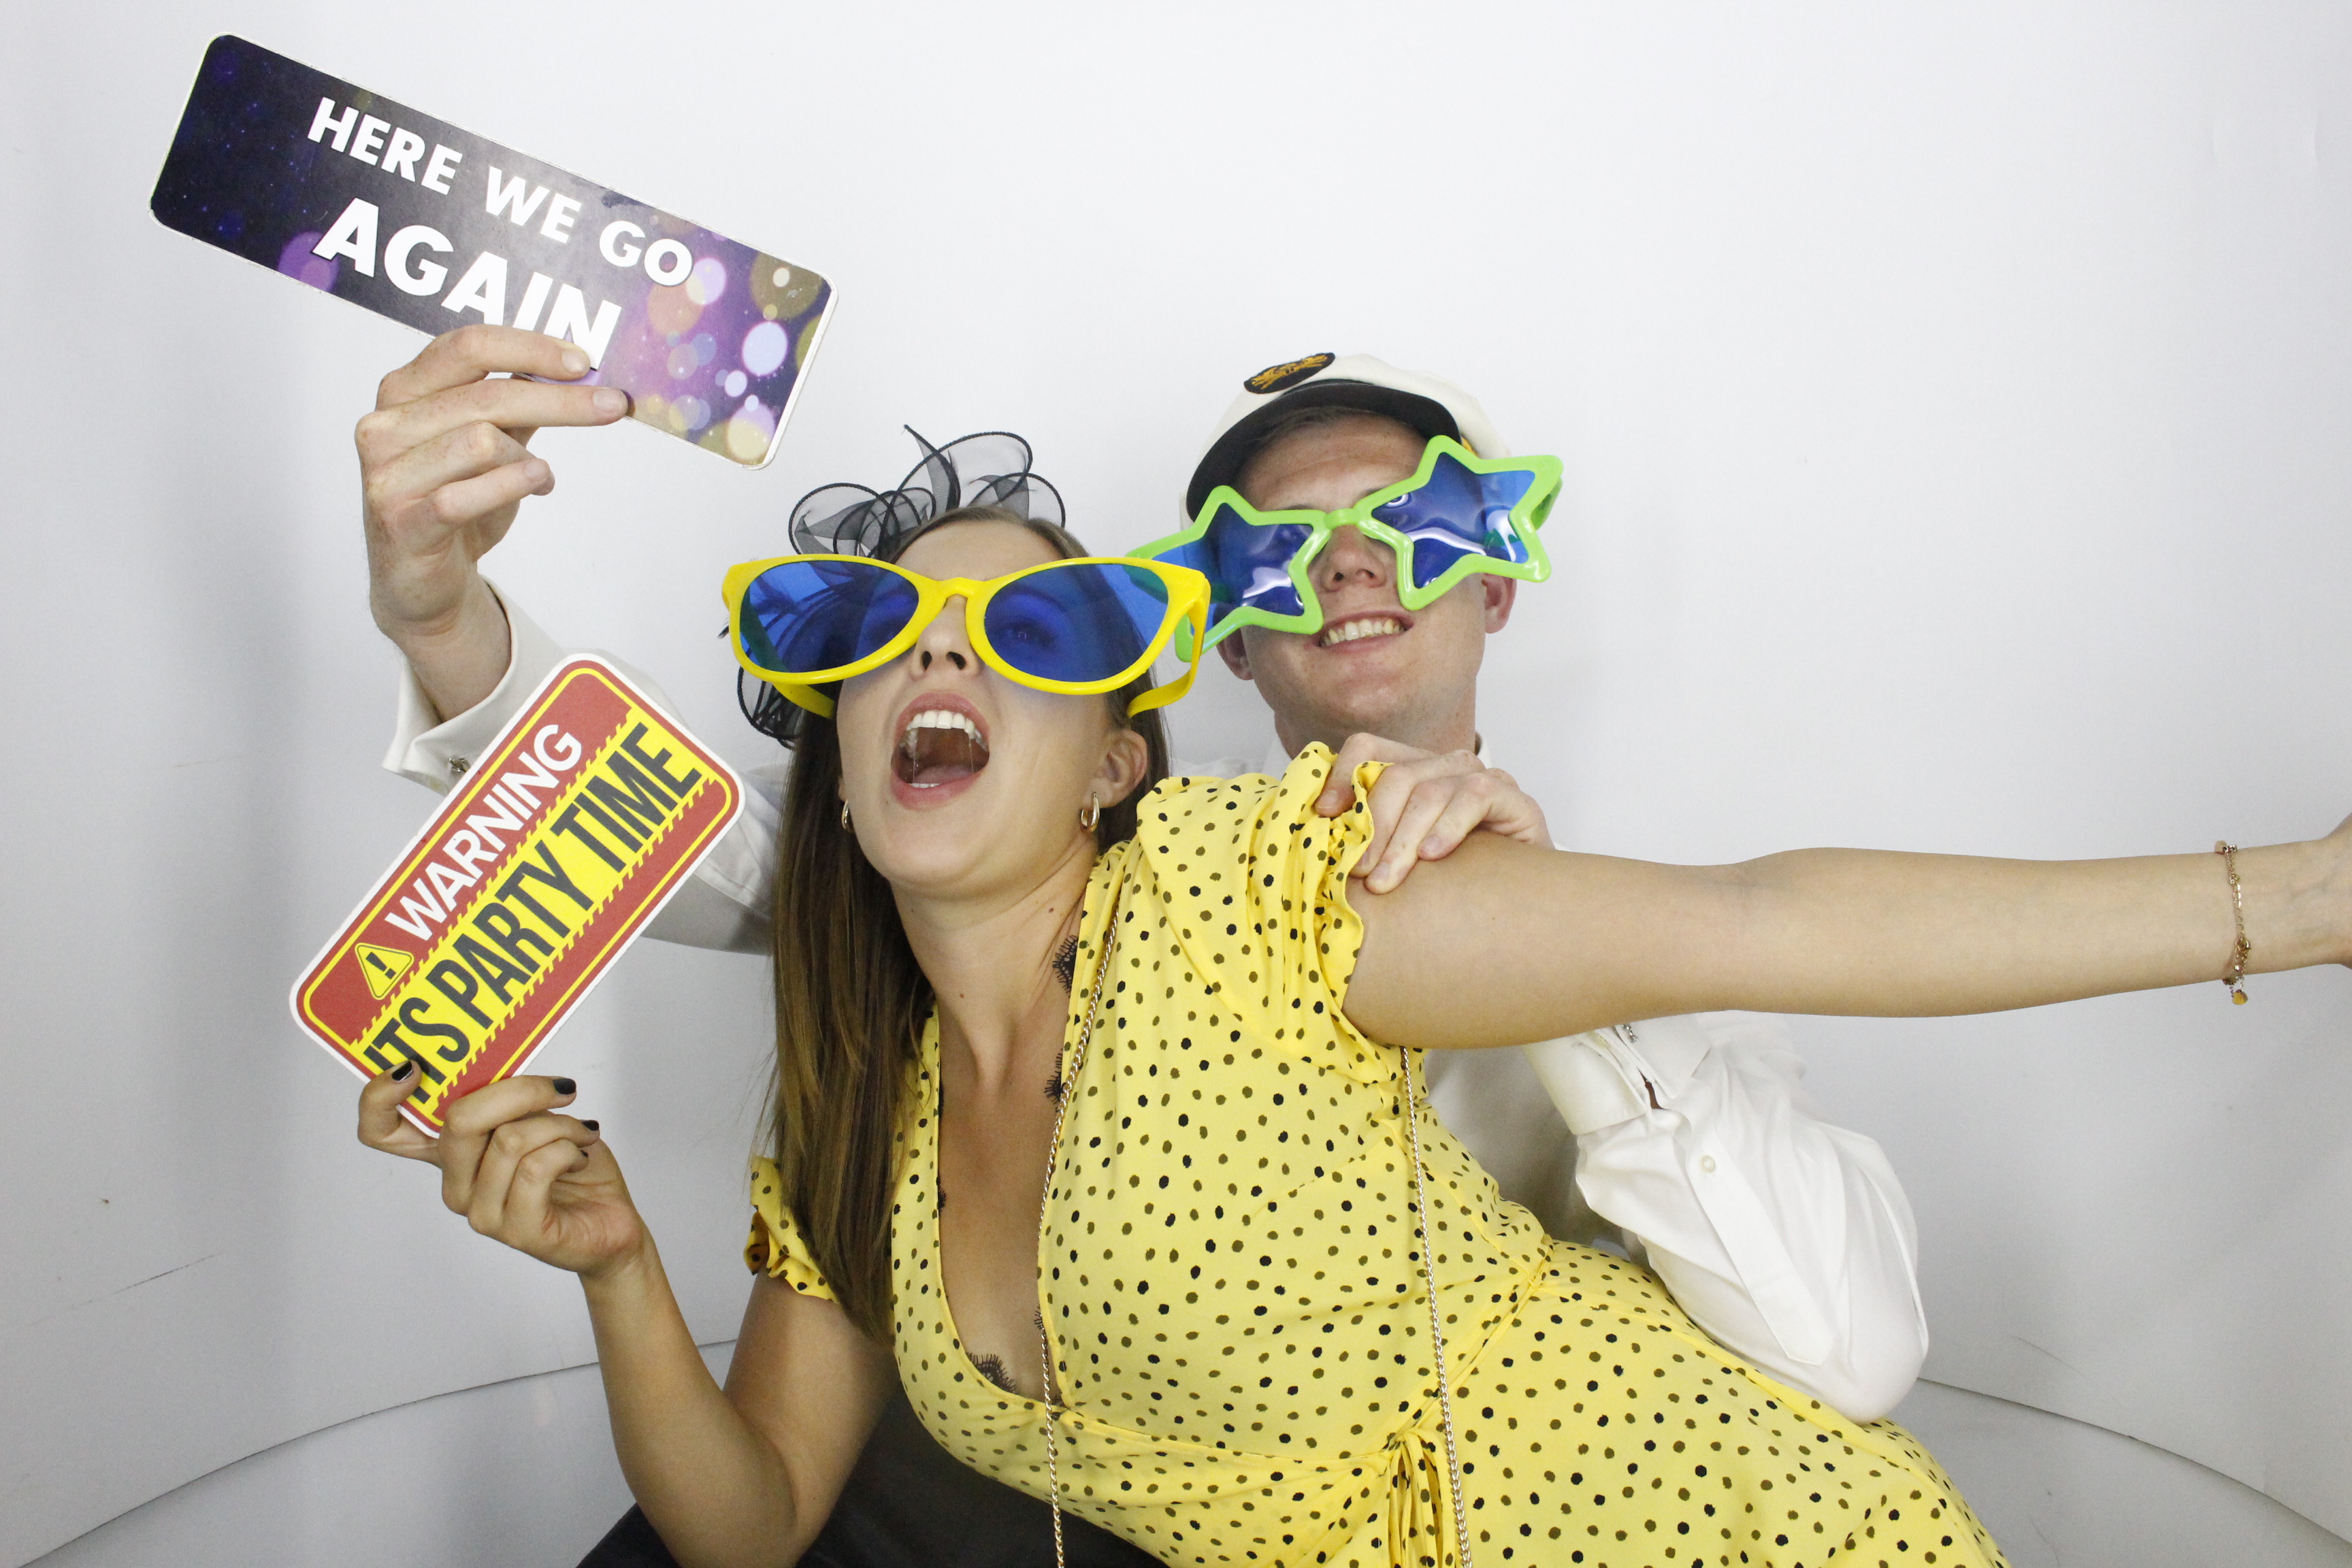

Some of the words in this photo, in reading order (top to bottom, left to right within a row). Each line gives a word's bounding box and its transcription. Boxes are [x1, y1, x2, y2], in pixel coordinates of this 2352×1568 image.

[307, 97, 463, 195] HERE
[484, 166, 583, 244] WE
[599, 220, 694, 287] GO
[312, 197, 623, 371] AGAIN
[384, 723, 583, 942] WARNING
[424, 838, 595, 1031] PARTY
[549, 721, 703, 874] TIME
